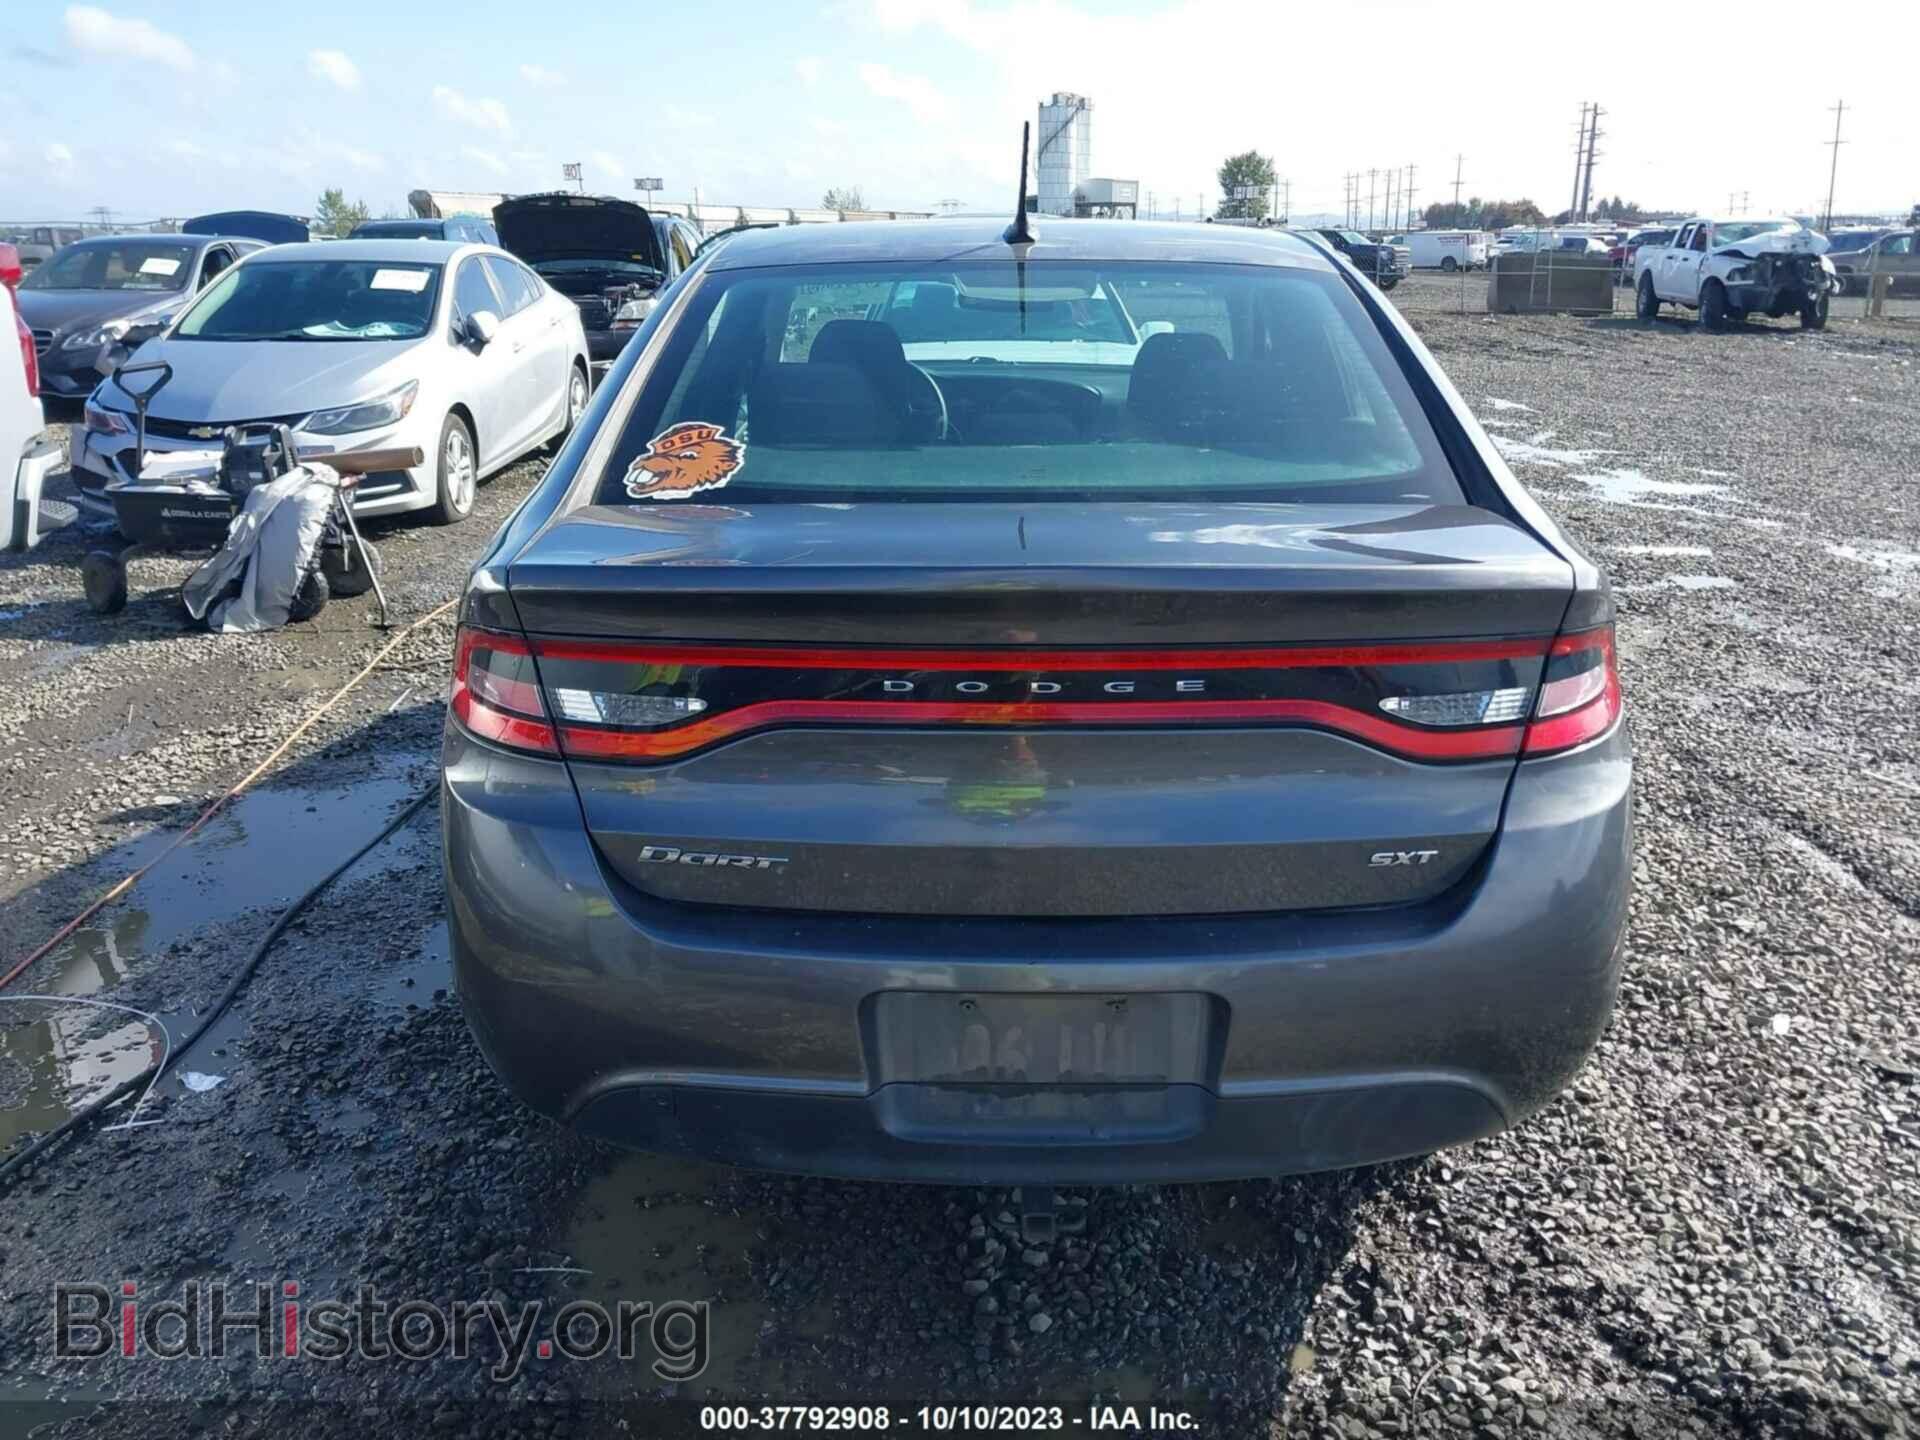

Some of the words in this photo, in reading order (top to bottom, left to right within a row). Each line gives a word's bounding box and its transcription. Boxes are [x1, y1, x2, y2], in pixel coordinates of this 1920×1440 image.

[660, 430, 712, 450] OSU
[883, 680, 1205, 693] DODGE
[1367, 850, 1439, 867] SXT
